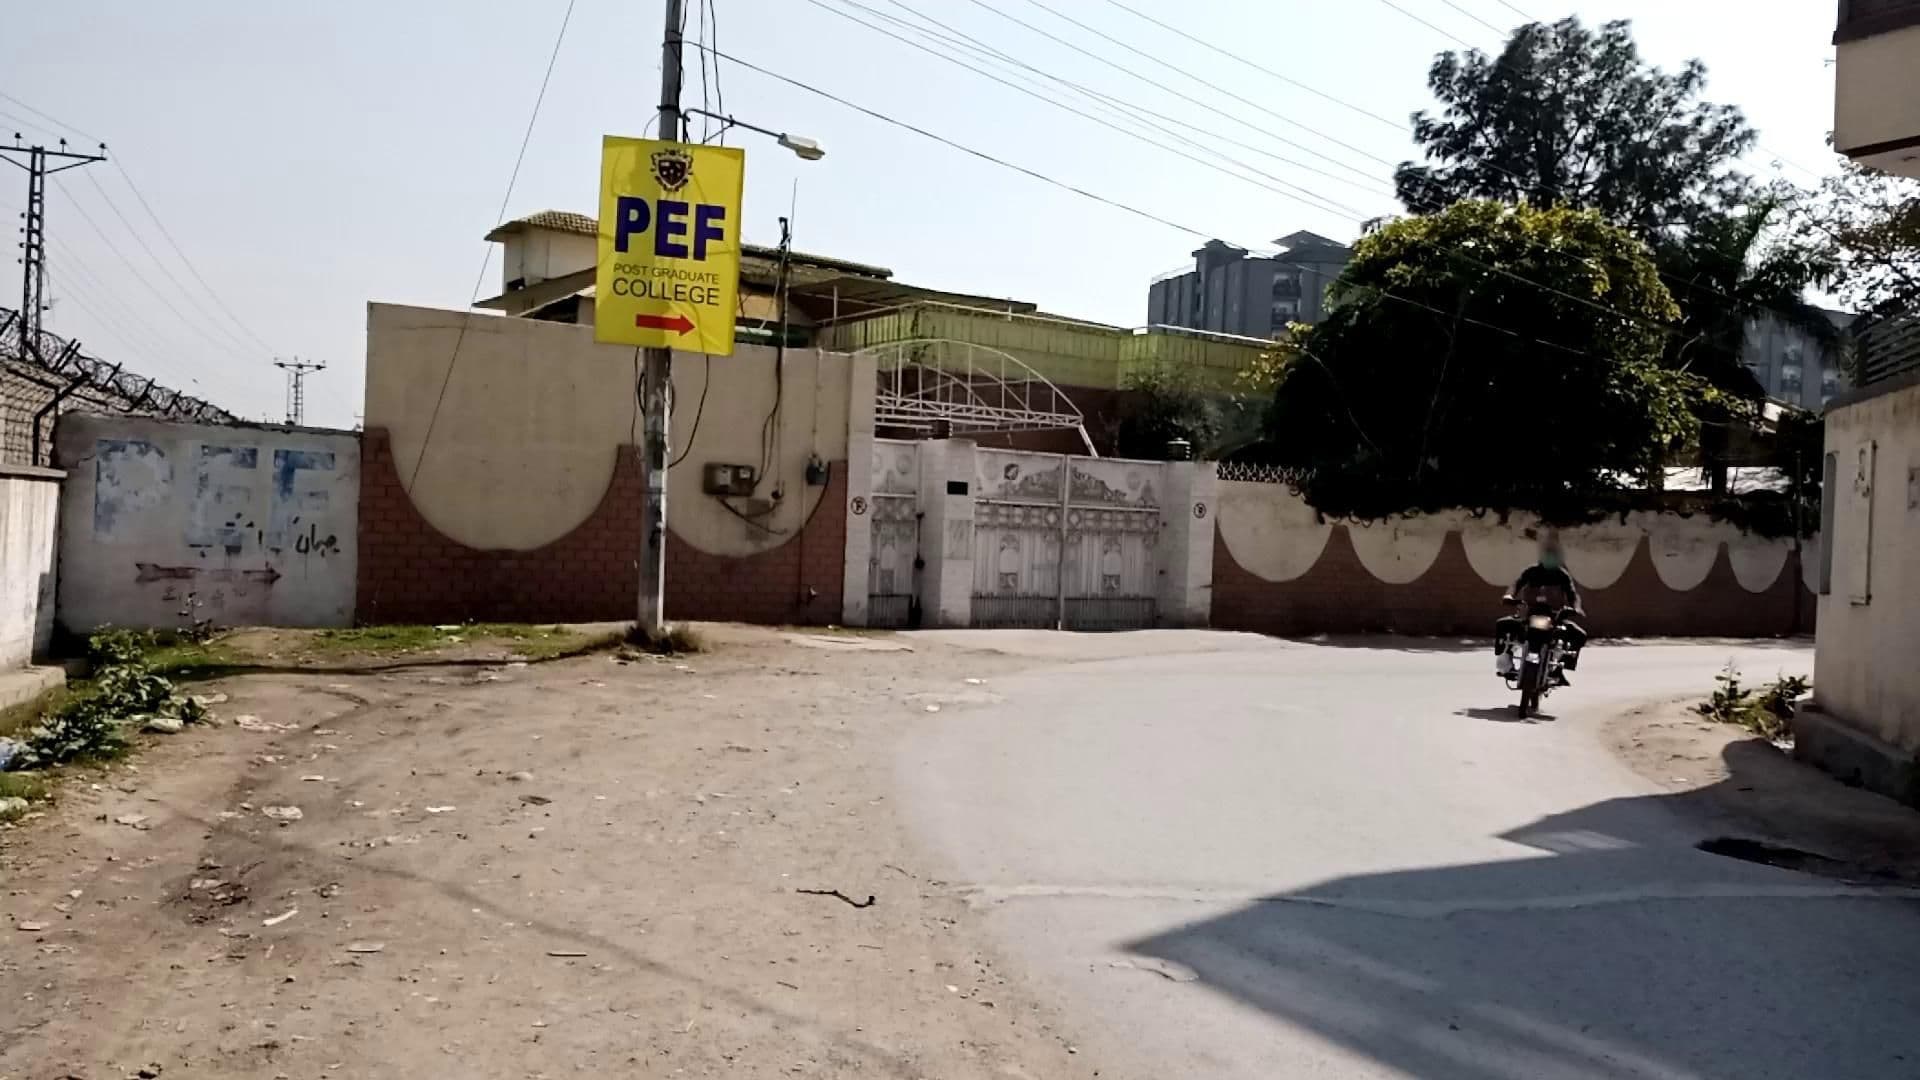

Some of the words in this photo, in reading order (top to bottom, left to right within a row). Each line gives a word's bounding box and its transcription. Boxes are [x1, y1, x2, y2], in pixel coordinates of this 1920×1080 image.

[614, 196, 725, 261] PEF
[613, 263, 648, 276] POST
[651, 267, 719, 284] GRADUATE
[613, 277, 720, 306] COLLEGE
